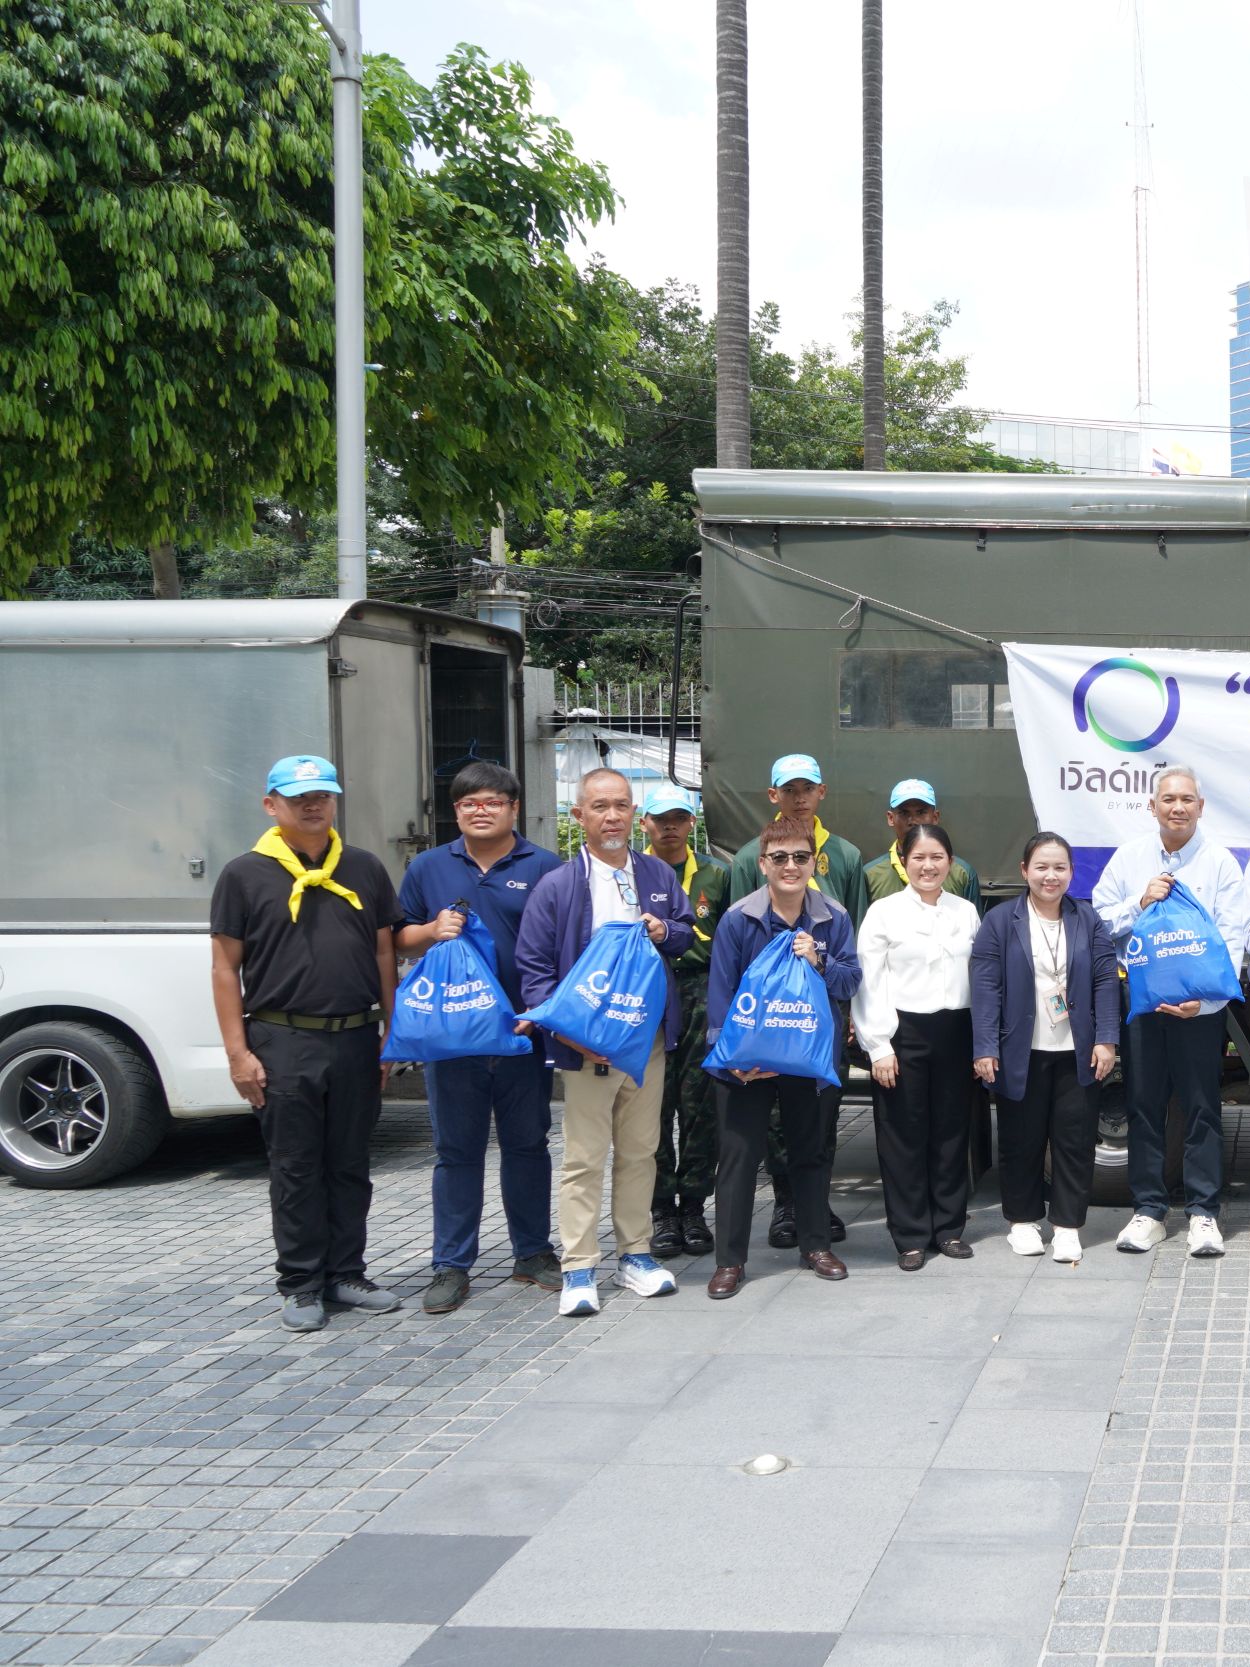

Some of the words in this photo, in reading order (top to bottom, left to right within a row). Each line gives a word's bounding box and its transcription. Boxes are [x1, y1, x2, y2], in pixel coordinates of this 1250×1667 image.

[1060, 760, 1168, 795] เวิลด์แก๊
[1126, 802, 1142, 811] WP
